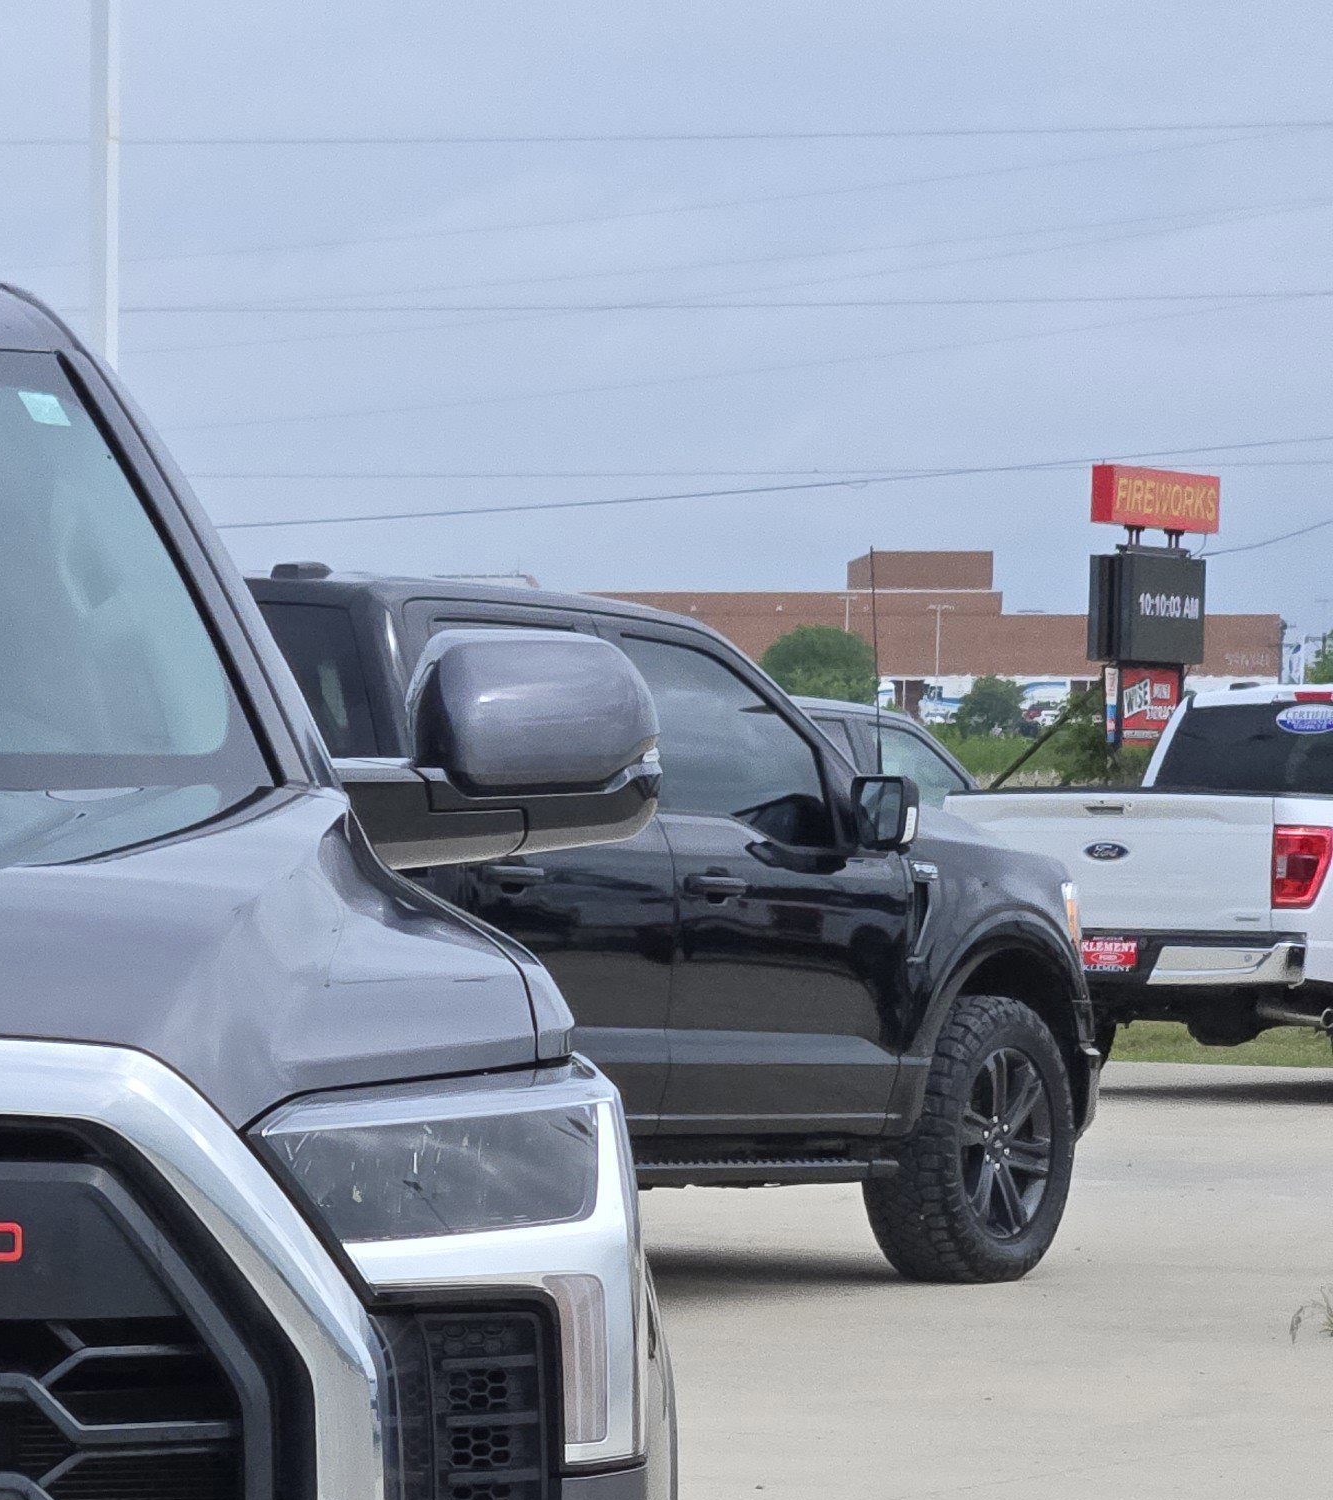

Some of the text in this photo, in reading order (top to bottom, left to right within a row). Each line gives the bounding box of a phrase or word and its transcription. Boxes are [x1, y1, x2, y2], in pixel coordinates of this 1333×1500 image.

[1116, 478, 1216, 521] FIREWORKS
[1183, 594, 1199, 619] AM
[1081, 941, 1137, 952] KLEMENT
